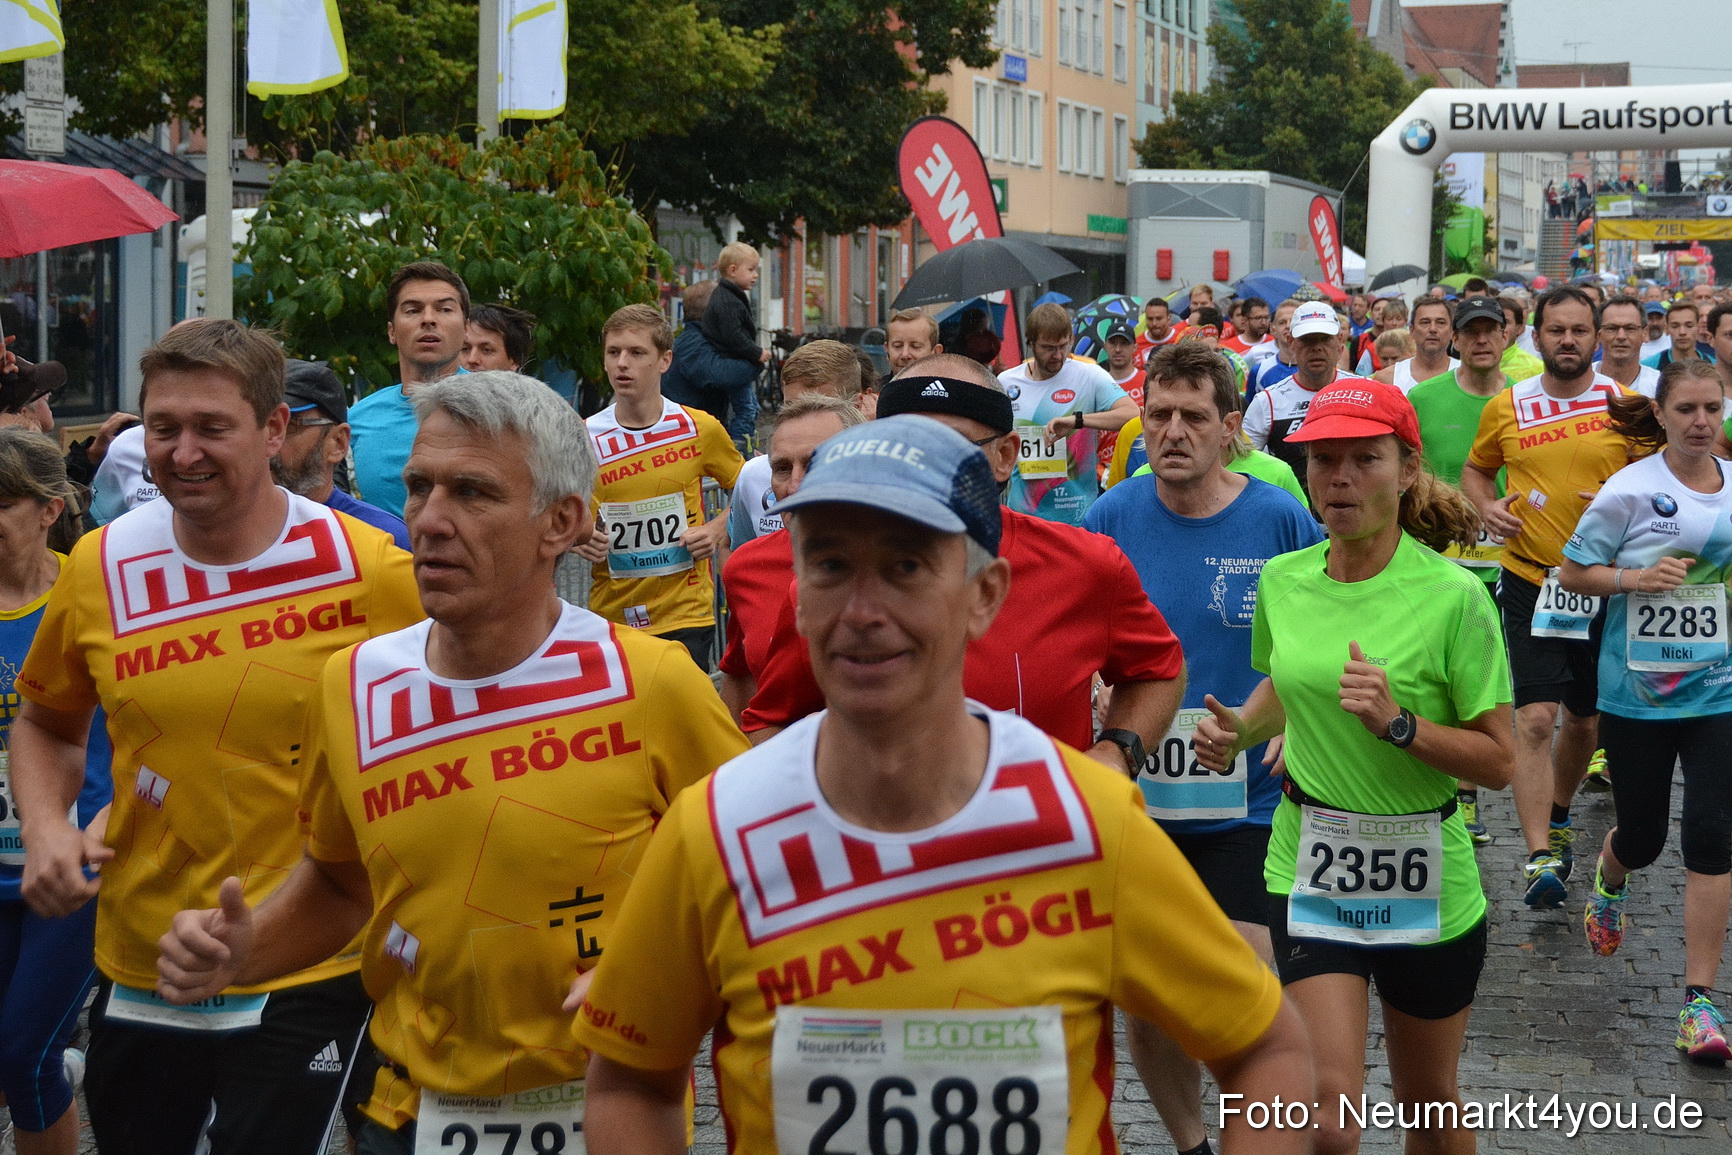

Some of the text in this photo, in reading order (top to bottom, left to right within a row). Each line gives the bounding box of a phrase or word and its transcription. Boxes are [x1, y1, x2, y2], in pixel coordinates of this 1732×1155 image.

[1449, 99, 1732, 134] BMW Laufsport
[1655, 223, 1689, 236] ZIEL
[921, 389, 949, 398] adidas
[1519, 427, 1568, 450] MAX
[824, 439, 927, 470] QUELLE.
[601, 444, 702, 486] MAX BÖGL
[1053, 487, 1068, 496] 17.
[635, 496, 677, 513] BOCK
[611, 513, 680, 550] 2702
[759, 518, 784, 528] PARTL
[1651, 521, 1680, 530] PARTL
[631, 553, 670, 567] Yannik
[1204, 557, 1219, 565] 12.
[1542, 583, 1593, 614] 2686
[1671, 587, 1718, 598] BOCK
[1638, 605, 1718, 638] 2283
[115, 599, 367, 682] MAX BÖGL
[1661, 646, 1693, 660] Nicki
[362, 721, 642, 823] MAX BÖGL
[1310, 821, 1350, 836] NeuerMarkt
[1358, 819, 1429, 836] BOCK
[1308, 841, 1428, 893] 2356
[1337, 905, 1391, 928] Ingrid
[756, 888, 1114, 1012] MAX BÖGL
[903, 1019, 1040, 1051] BOCK
[797, 1040, 886, 1055] NeuerMarkt
[310, 1059, 342, 1072] adidas
[437, 1097, 501, 1108] NeuerMarkt
[807, 1075, 1041, 1155] 2688
